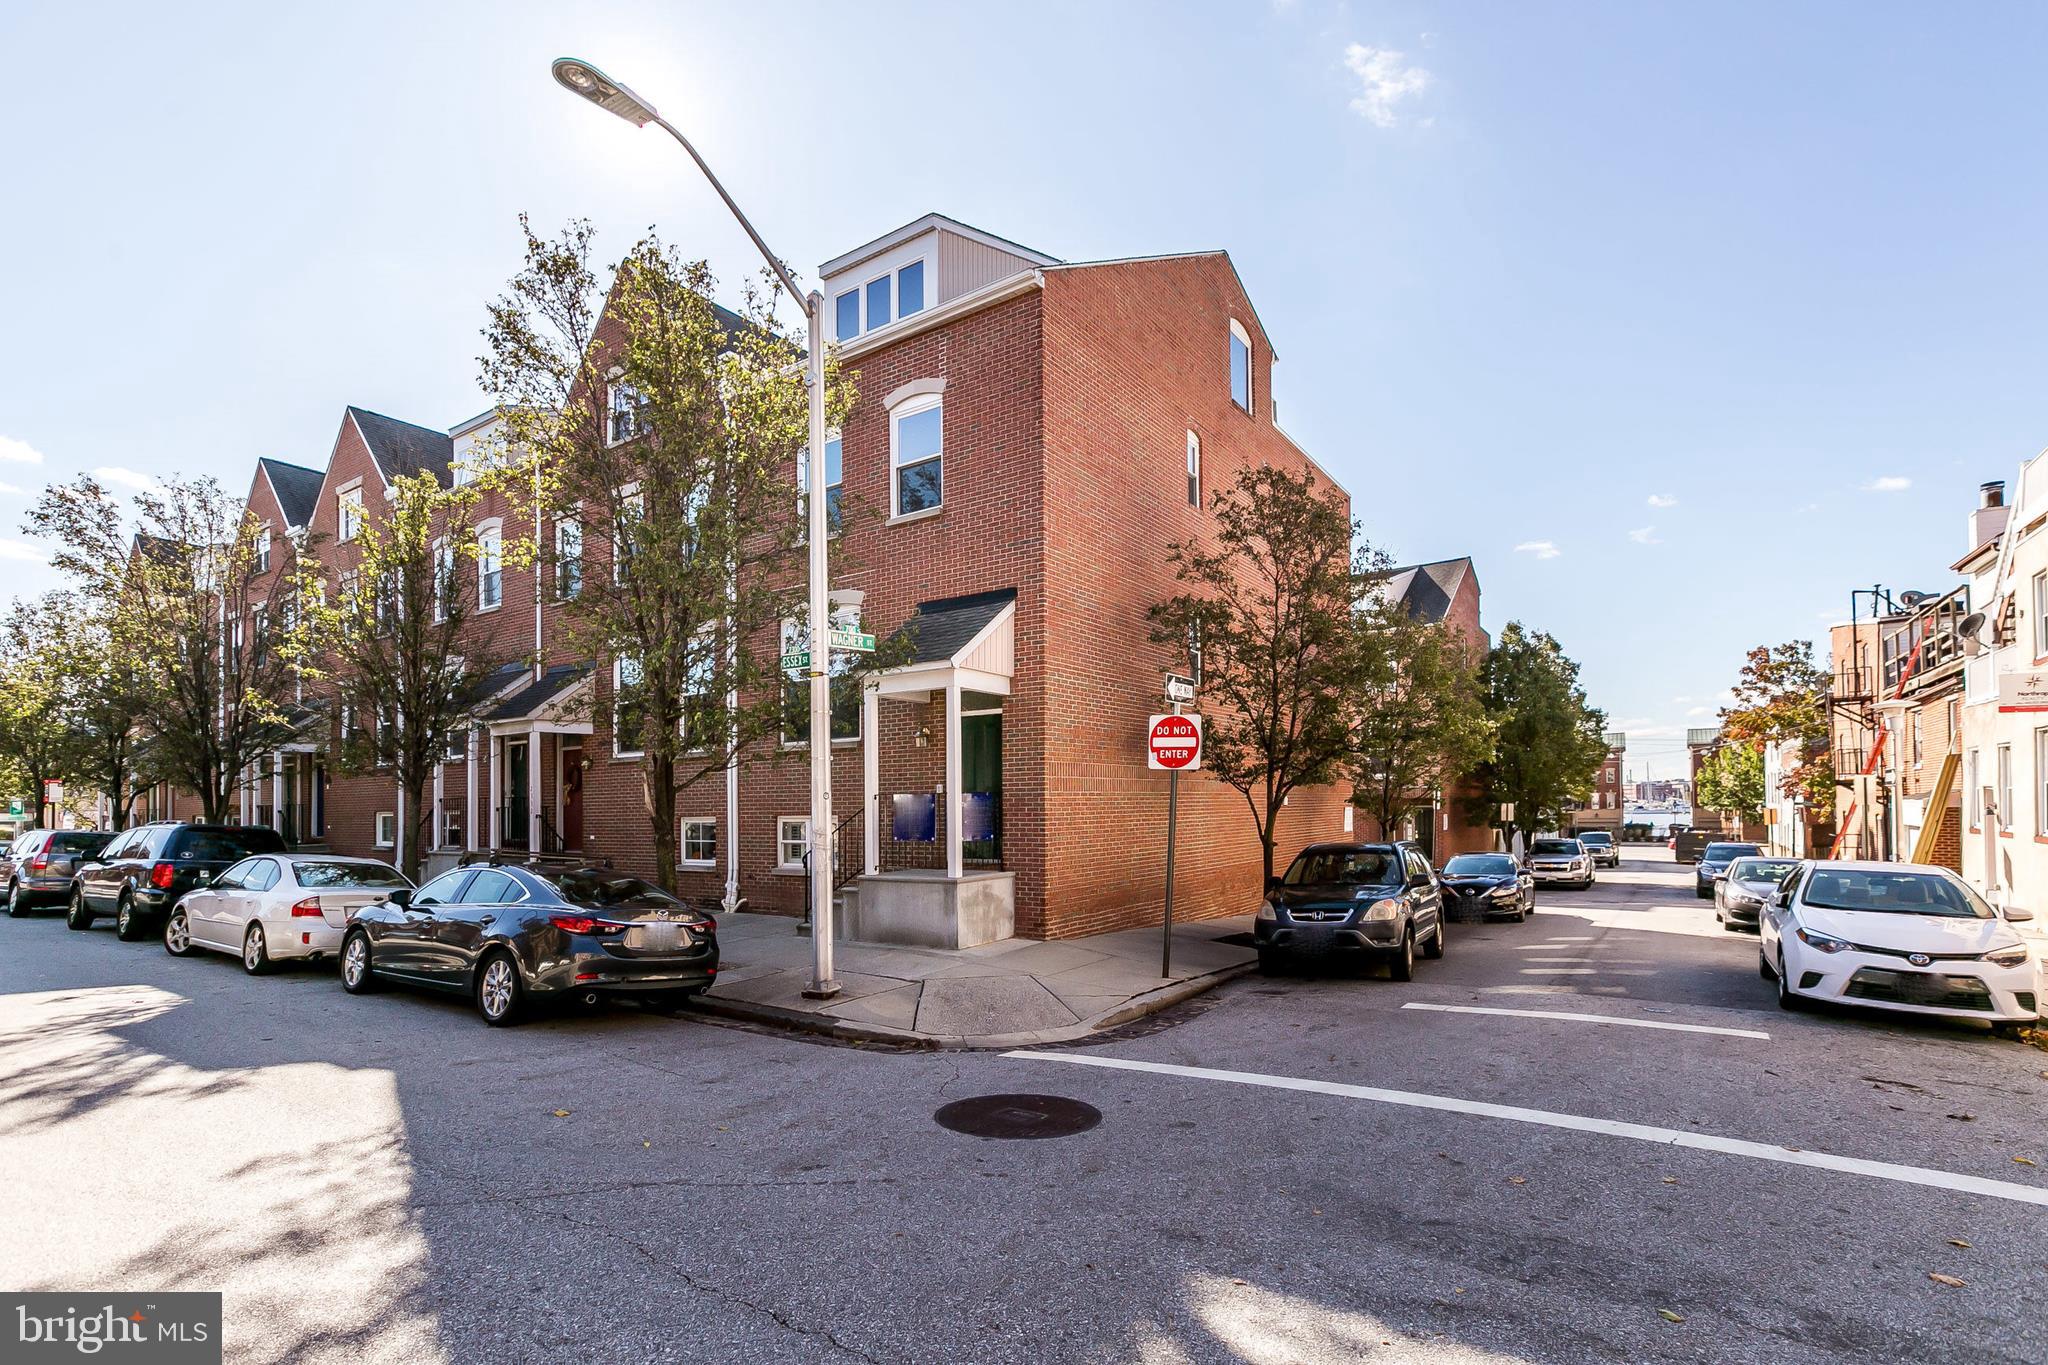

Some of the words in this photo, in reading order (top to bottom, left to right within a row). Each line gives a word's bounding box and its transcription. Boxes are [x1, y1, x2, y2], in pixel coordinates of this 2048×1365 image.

[831, 633, 864, 647] WAGNER
[782, 655, 803, 668] ESSEX
[1156, 726, 1170, 735] DO
[1173, 725, 1192, 735] NOT
[1159, 749, 1189, 759] ENTER
